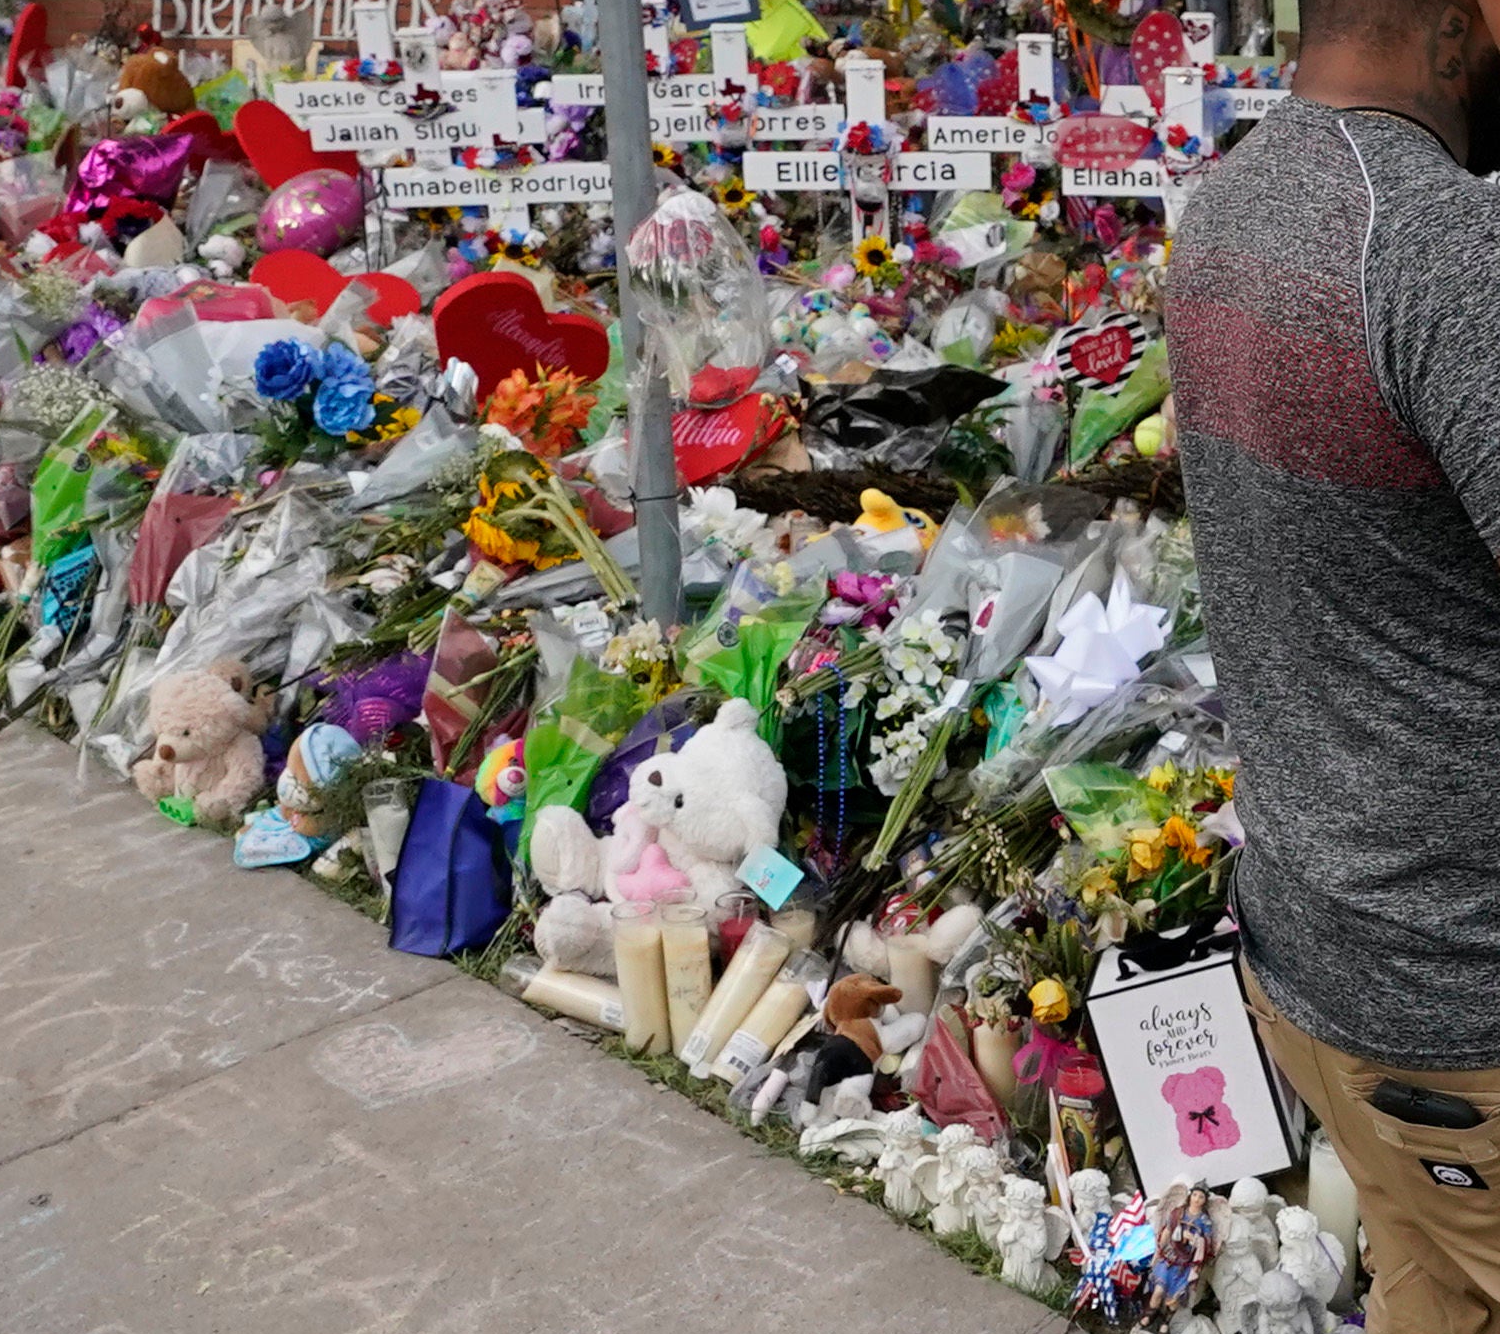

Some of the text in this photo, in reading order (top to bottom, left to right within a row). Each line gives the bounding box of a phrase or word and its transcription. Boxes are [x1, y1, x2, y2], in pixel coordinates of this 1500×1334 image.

[933, 125, 1028, 146] Amerie
[1034, 125, 1060, 145] Jo
[776, 160, 839, 183] Ellie
[1085, 340, 1126, 374] loved
[1139, 1002, 1213, 1031] always
[1146, 1028, 1218, 1066] forever
